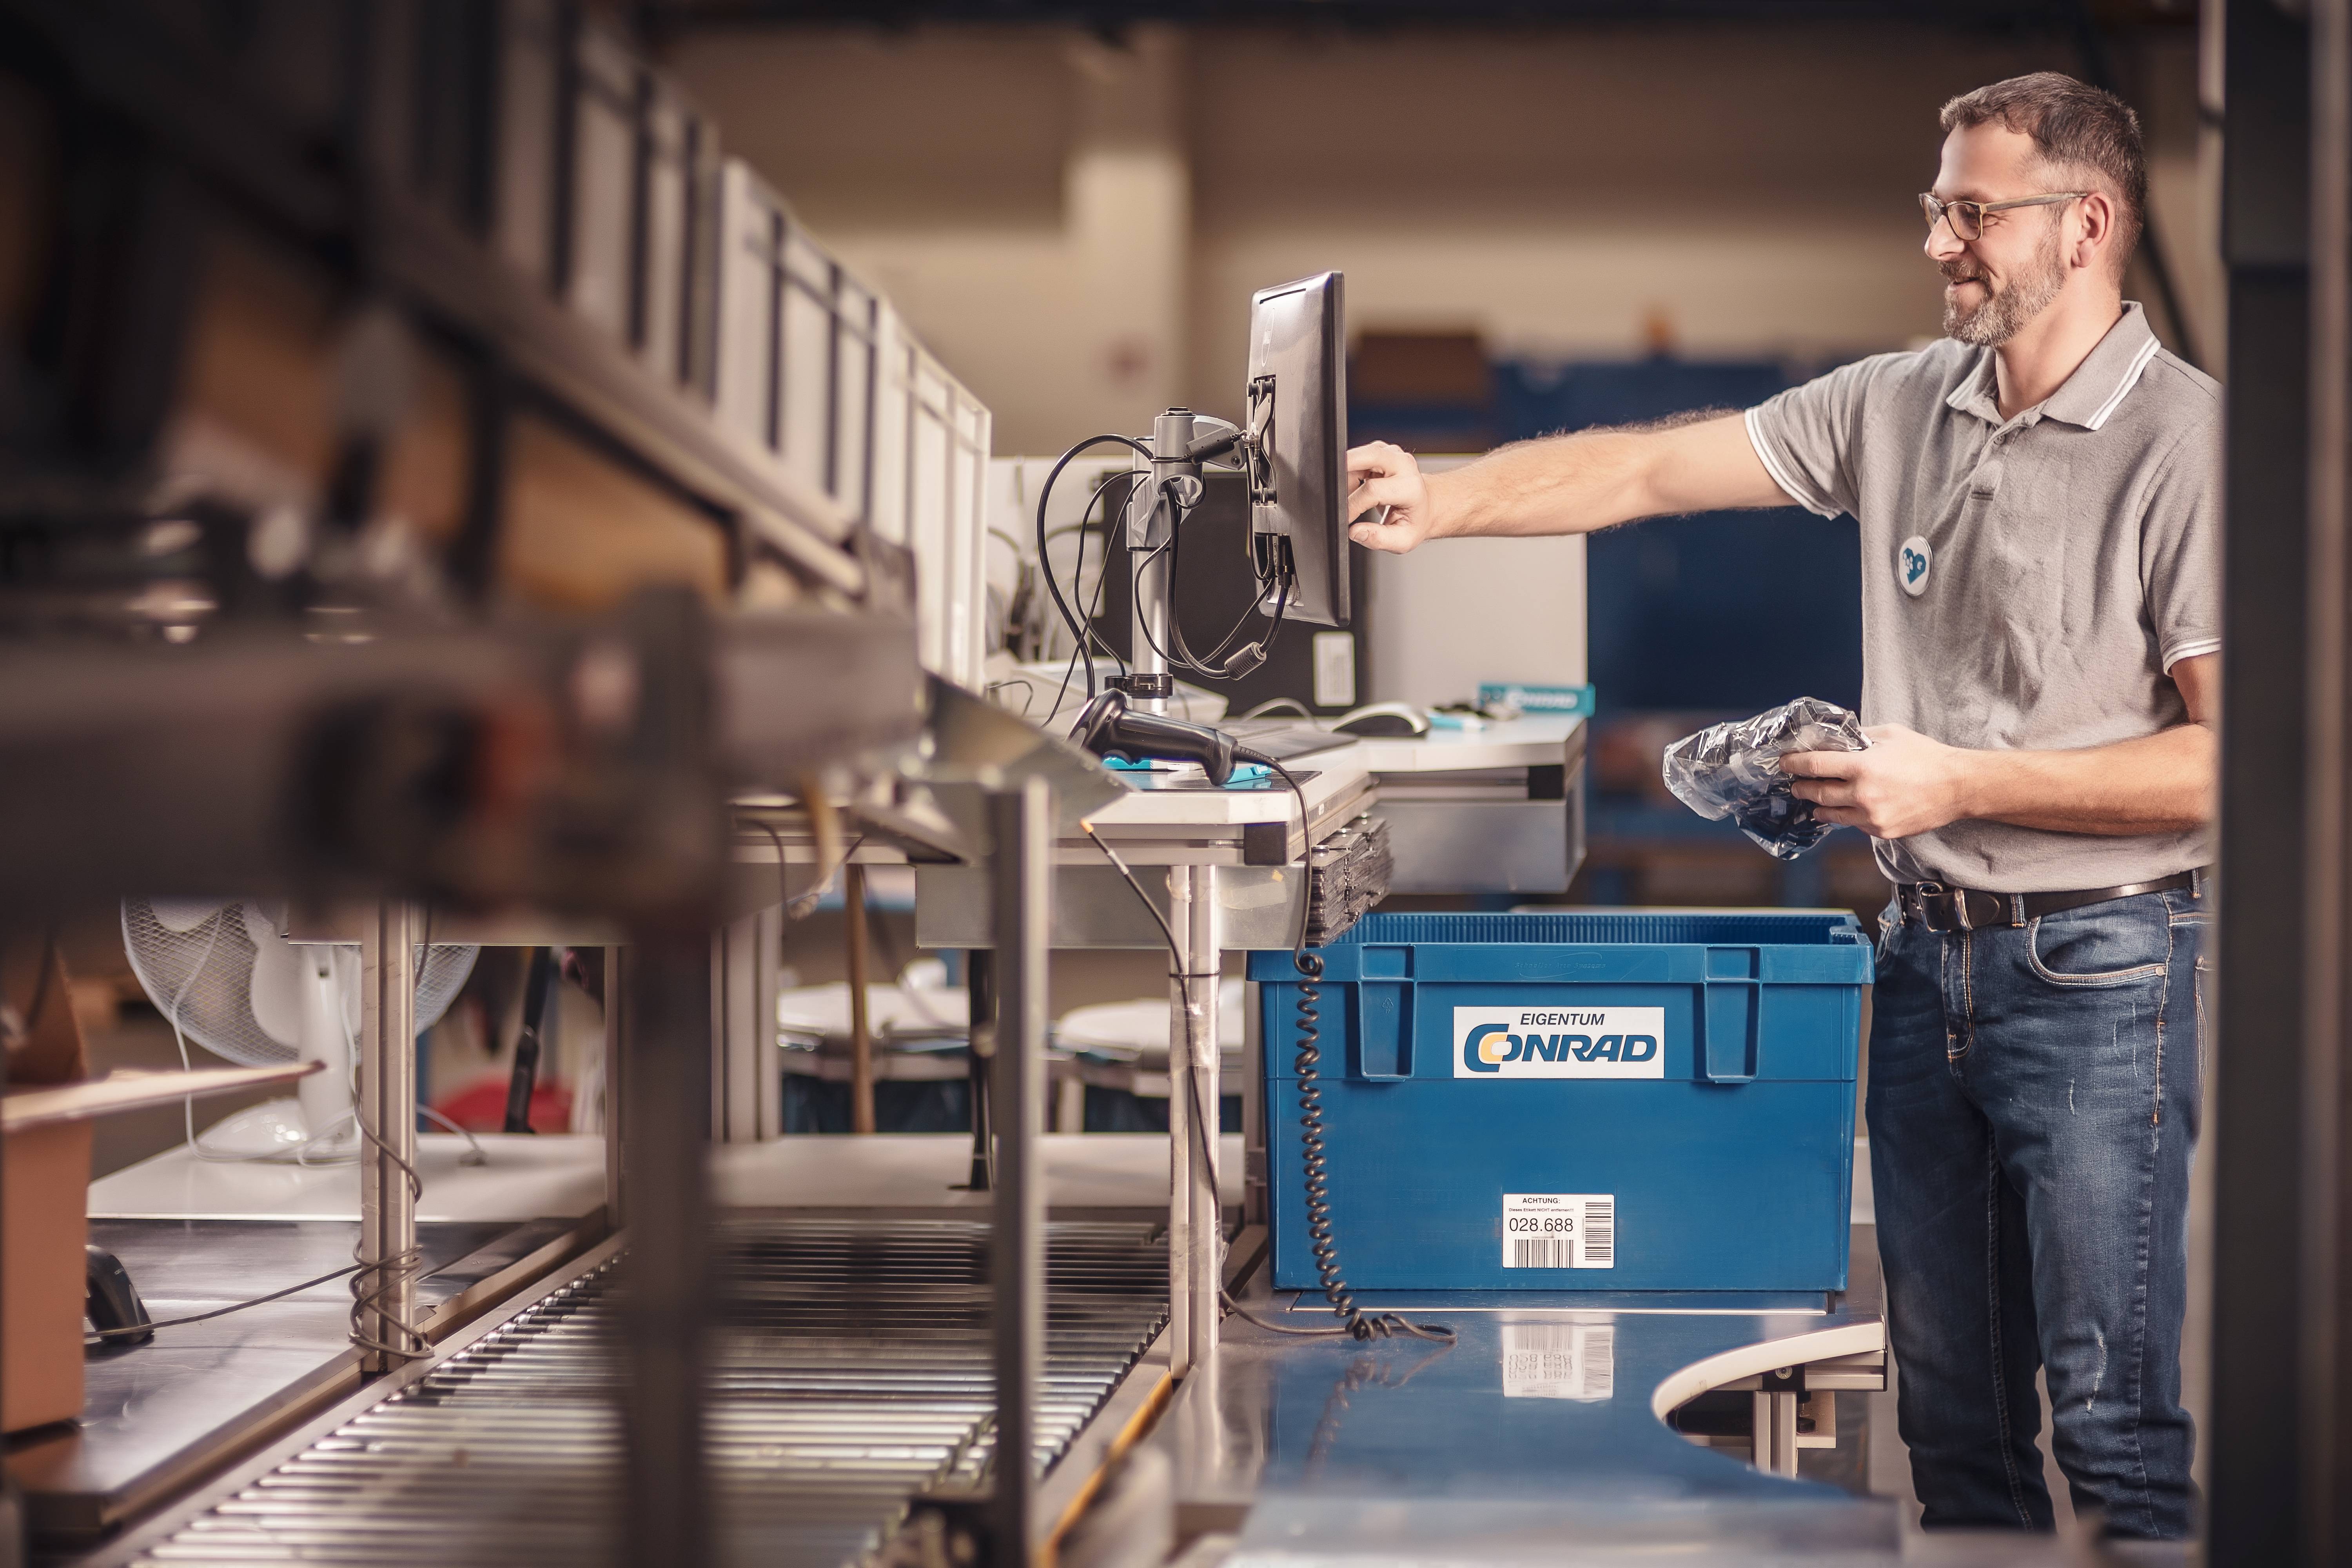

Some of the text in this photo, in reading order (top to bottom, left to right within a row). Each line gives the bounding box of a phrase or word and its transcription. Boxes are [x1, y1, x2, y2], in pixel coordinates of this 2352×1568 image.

[1520, 1013, 1605, 1025] EIGENTUM
[1464, 1024, 1657, 1073] CONRAD
[1509, 1218, 1573, 1232] 028.688
